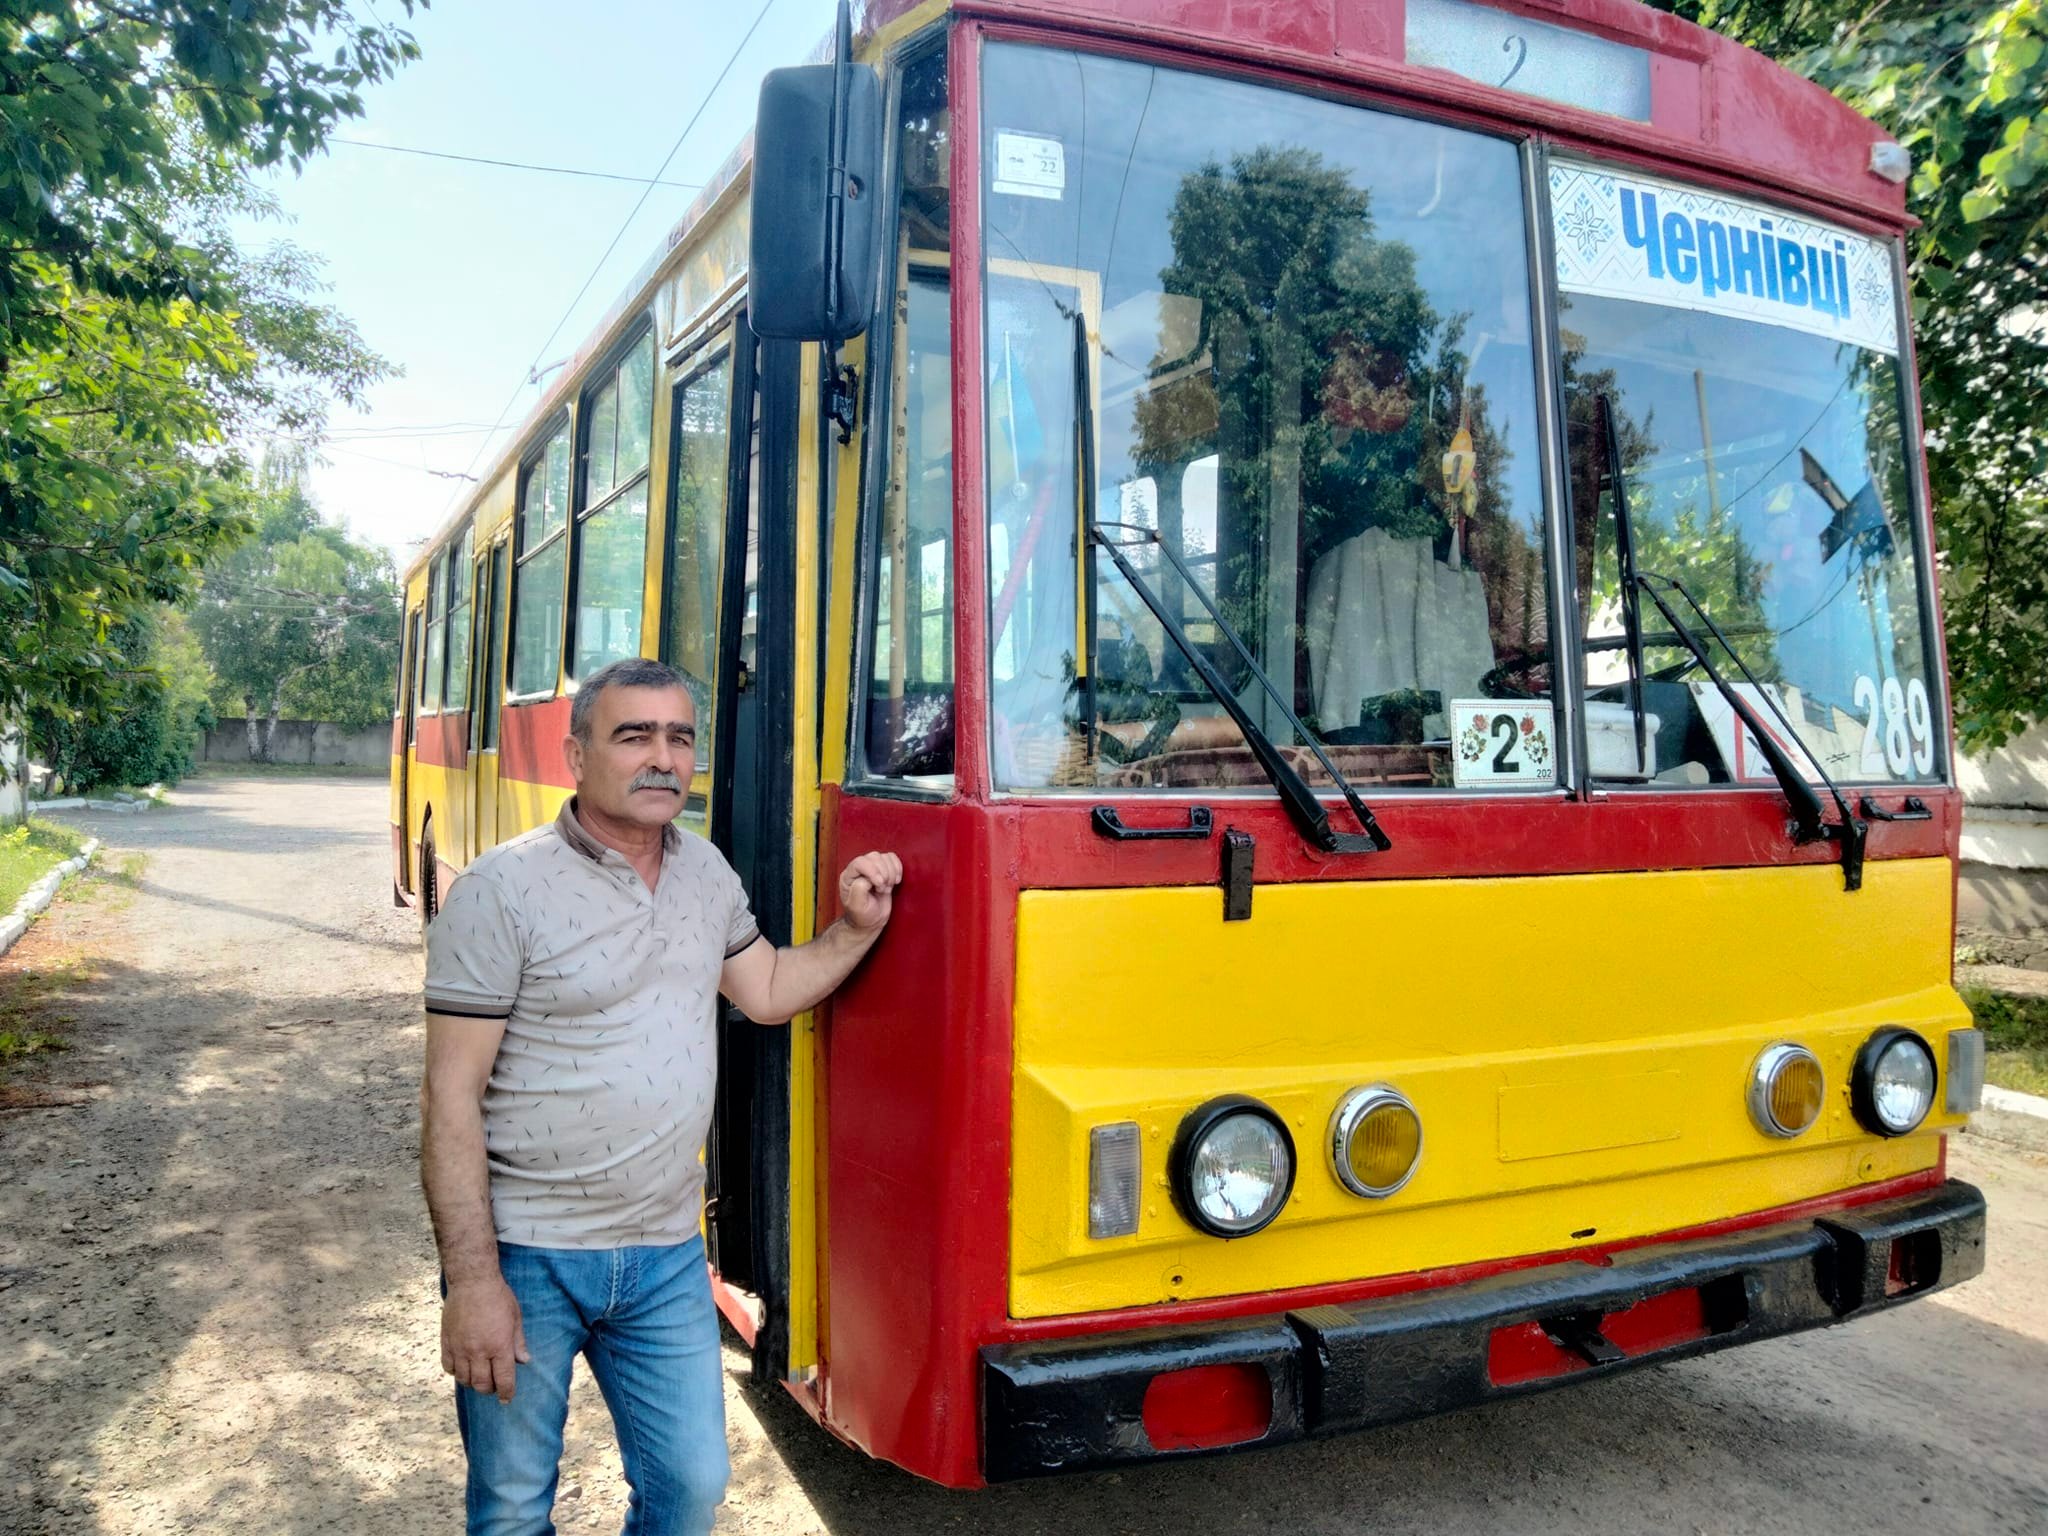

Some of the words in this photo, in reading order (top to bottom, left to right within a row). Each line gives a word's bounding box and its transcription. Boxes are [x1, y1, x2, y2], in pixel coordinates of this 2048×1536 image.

[1040, 160, 1057, 174] 22
[1618, 187, 1852, 323] Чернівці
[1490, 713, 1520, 773] 2
[1853, 675, 1934, 776] 289
[1536, 768, 1552, 778] 202
